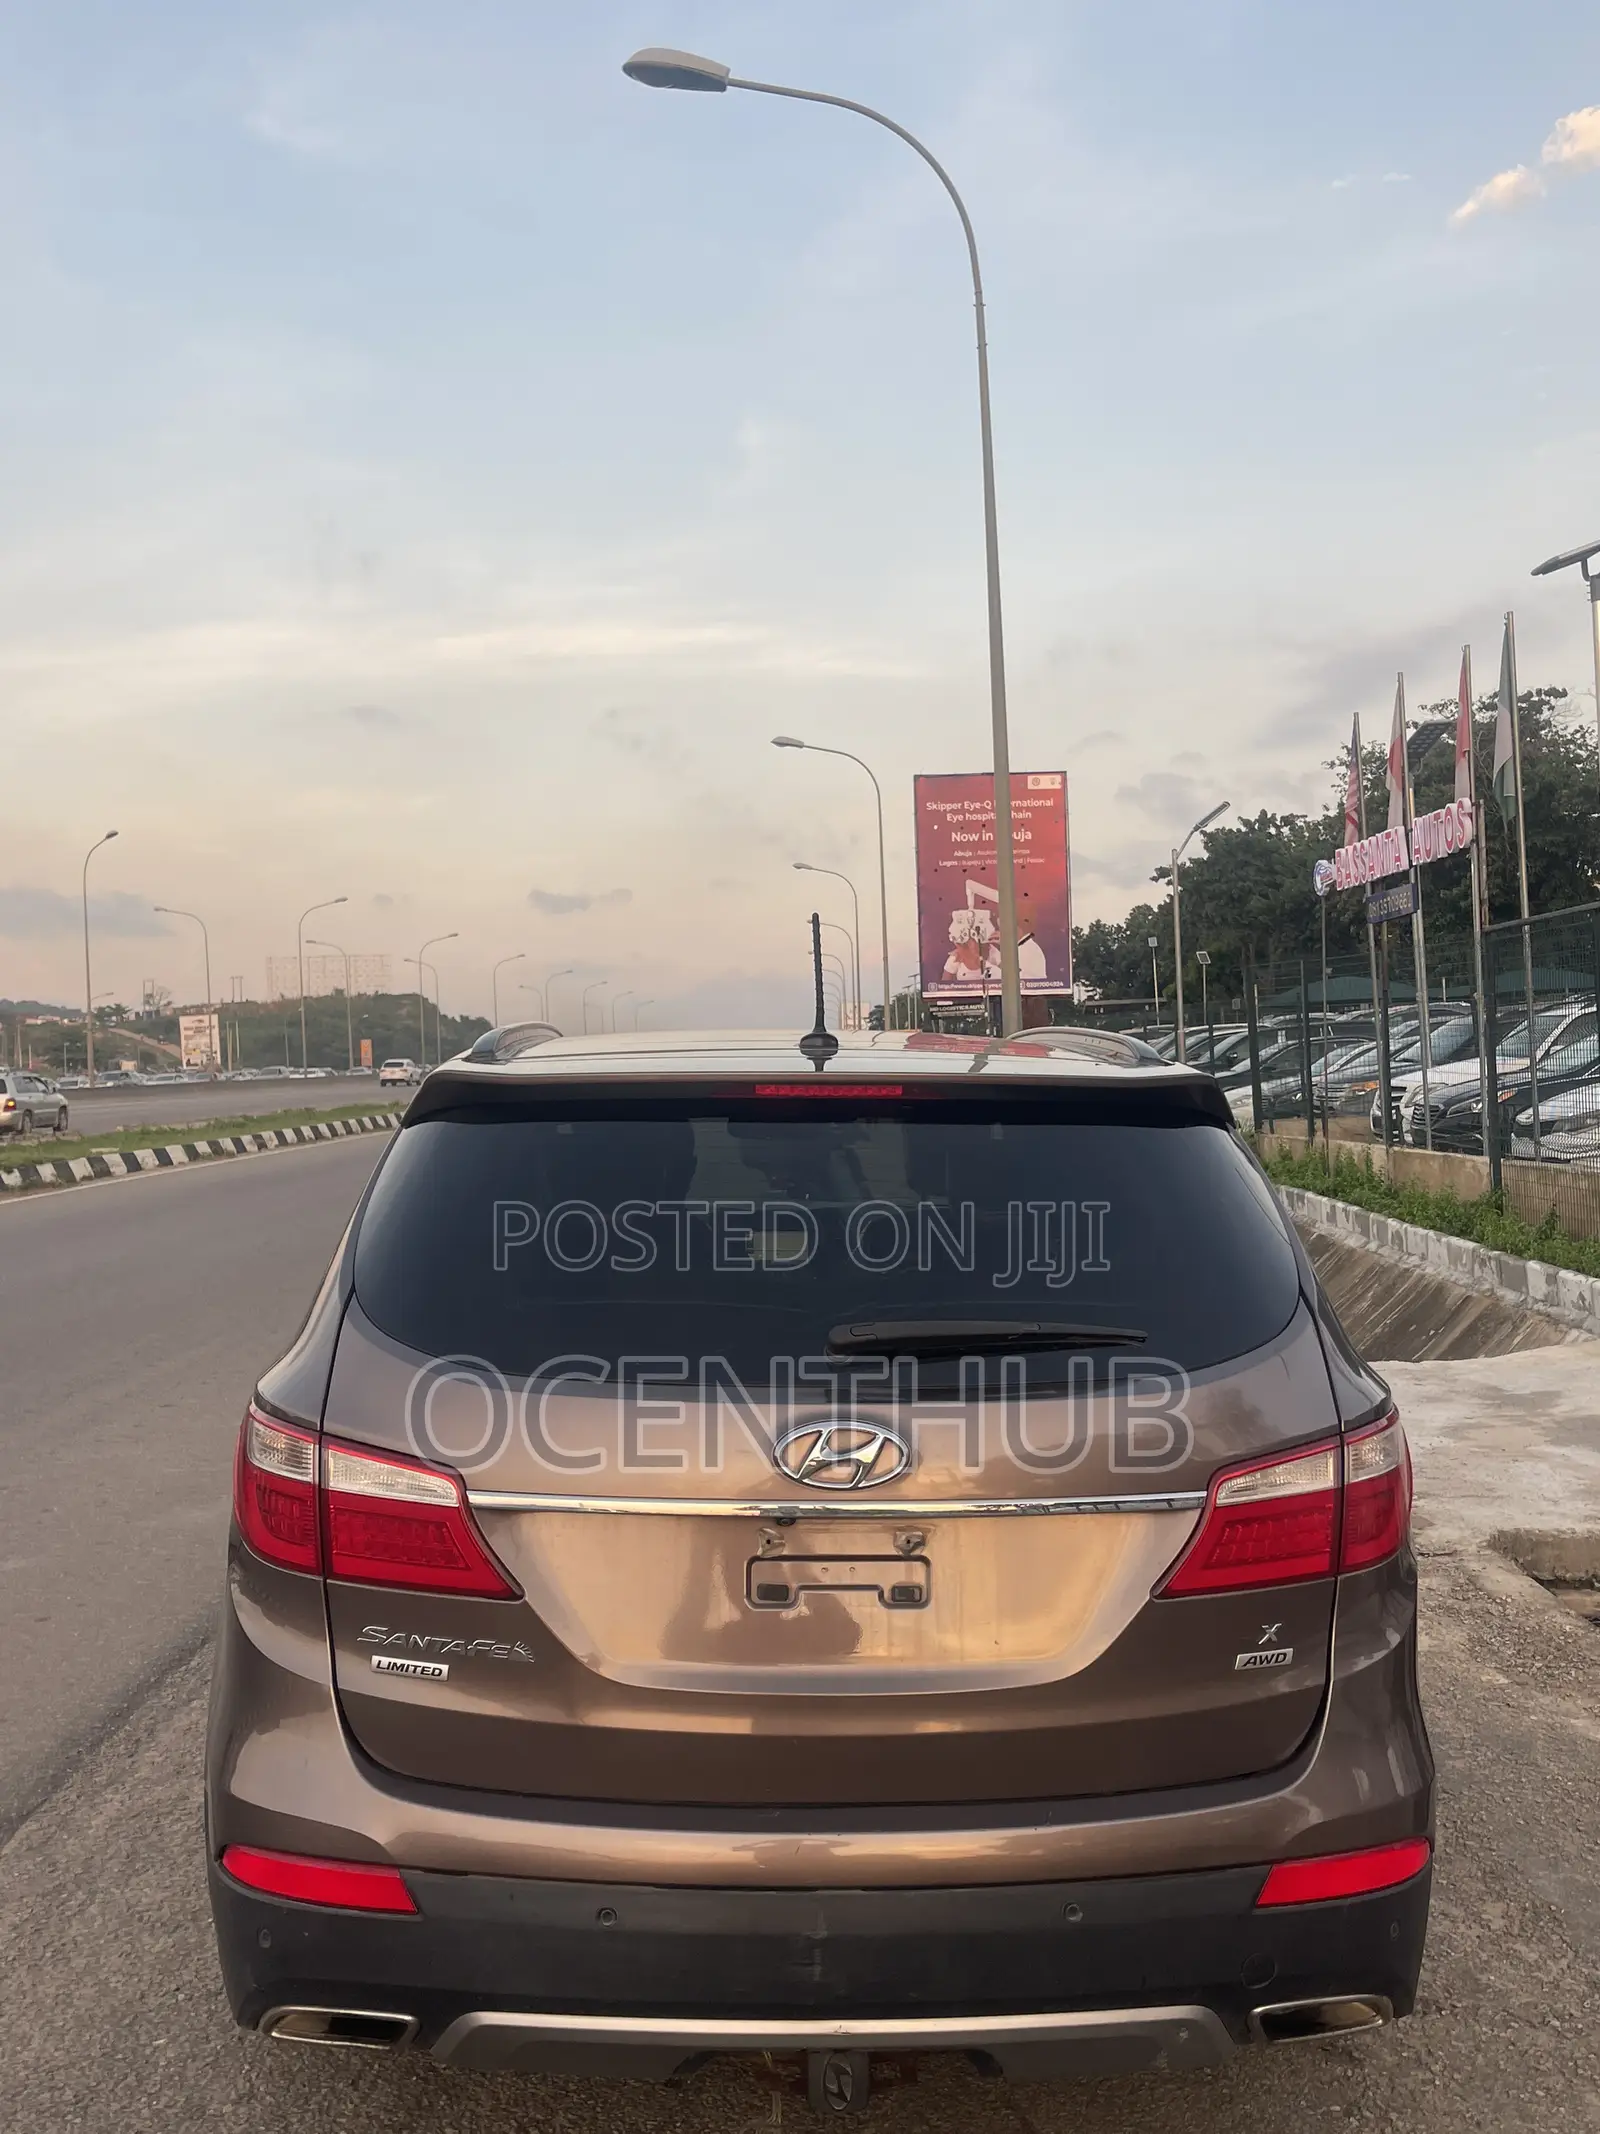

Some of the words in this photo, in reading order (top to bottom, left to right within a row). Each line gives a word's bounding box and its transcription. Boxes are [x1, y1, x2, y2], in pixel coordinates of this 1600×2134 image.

[926, 802, 962, 812] Skipper
[964, 800, 992, 811] Eye-Q
[946, 813, 964, 823] Eye
[951, 832, 979, 842] Now
[982, 829, 994, 841] in
[1335, 826, 1409, 891] BASSANTA
[1412, 798, 1473, 866] AUTOS
[1241, 1652, 1288, 1668] AWD
[375, 1659, 443, 1677] LIMITED
